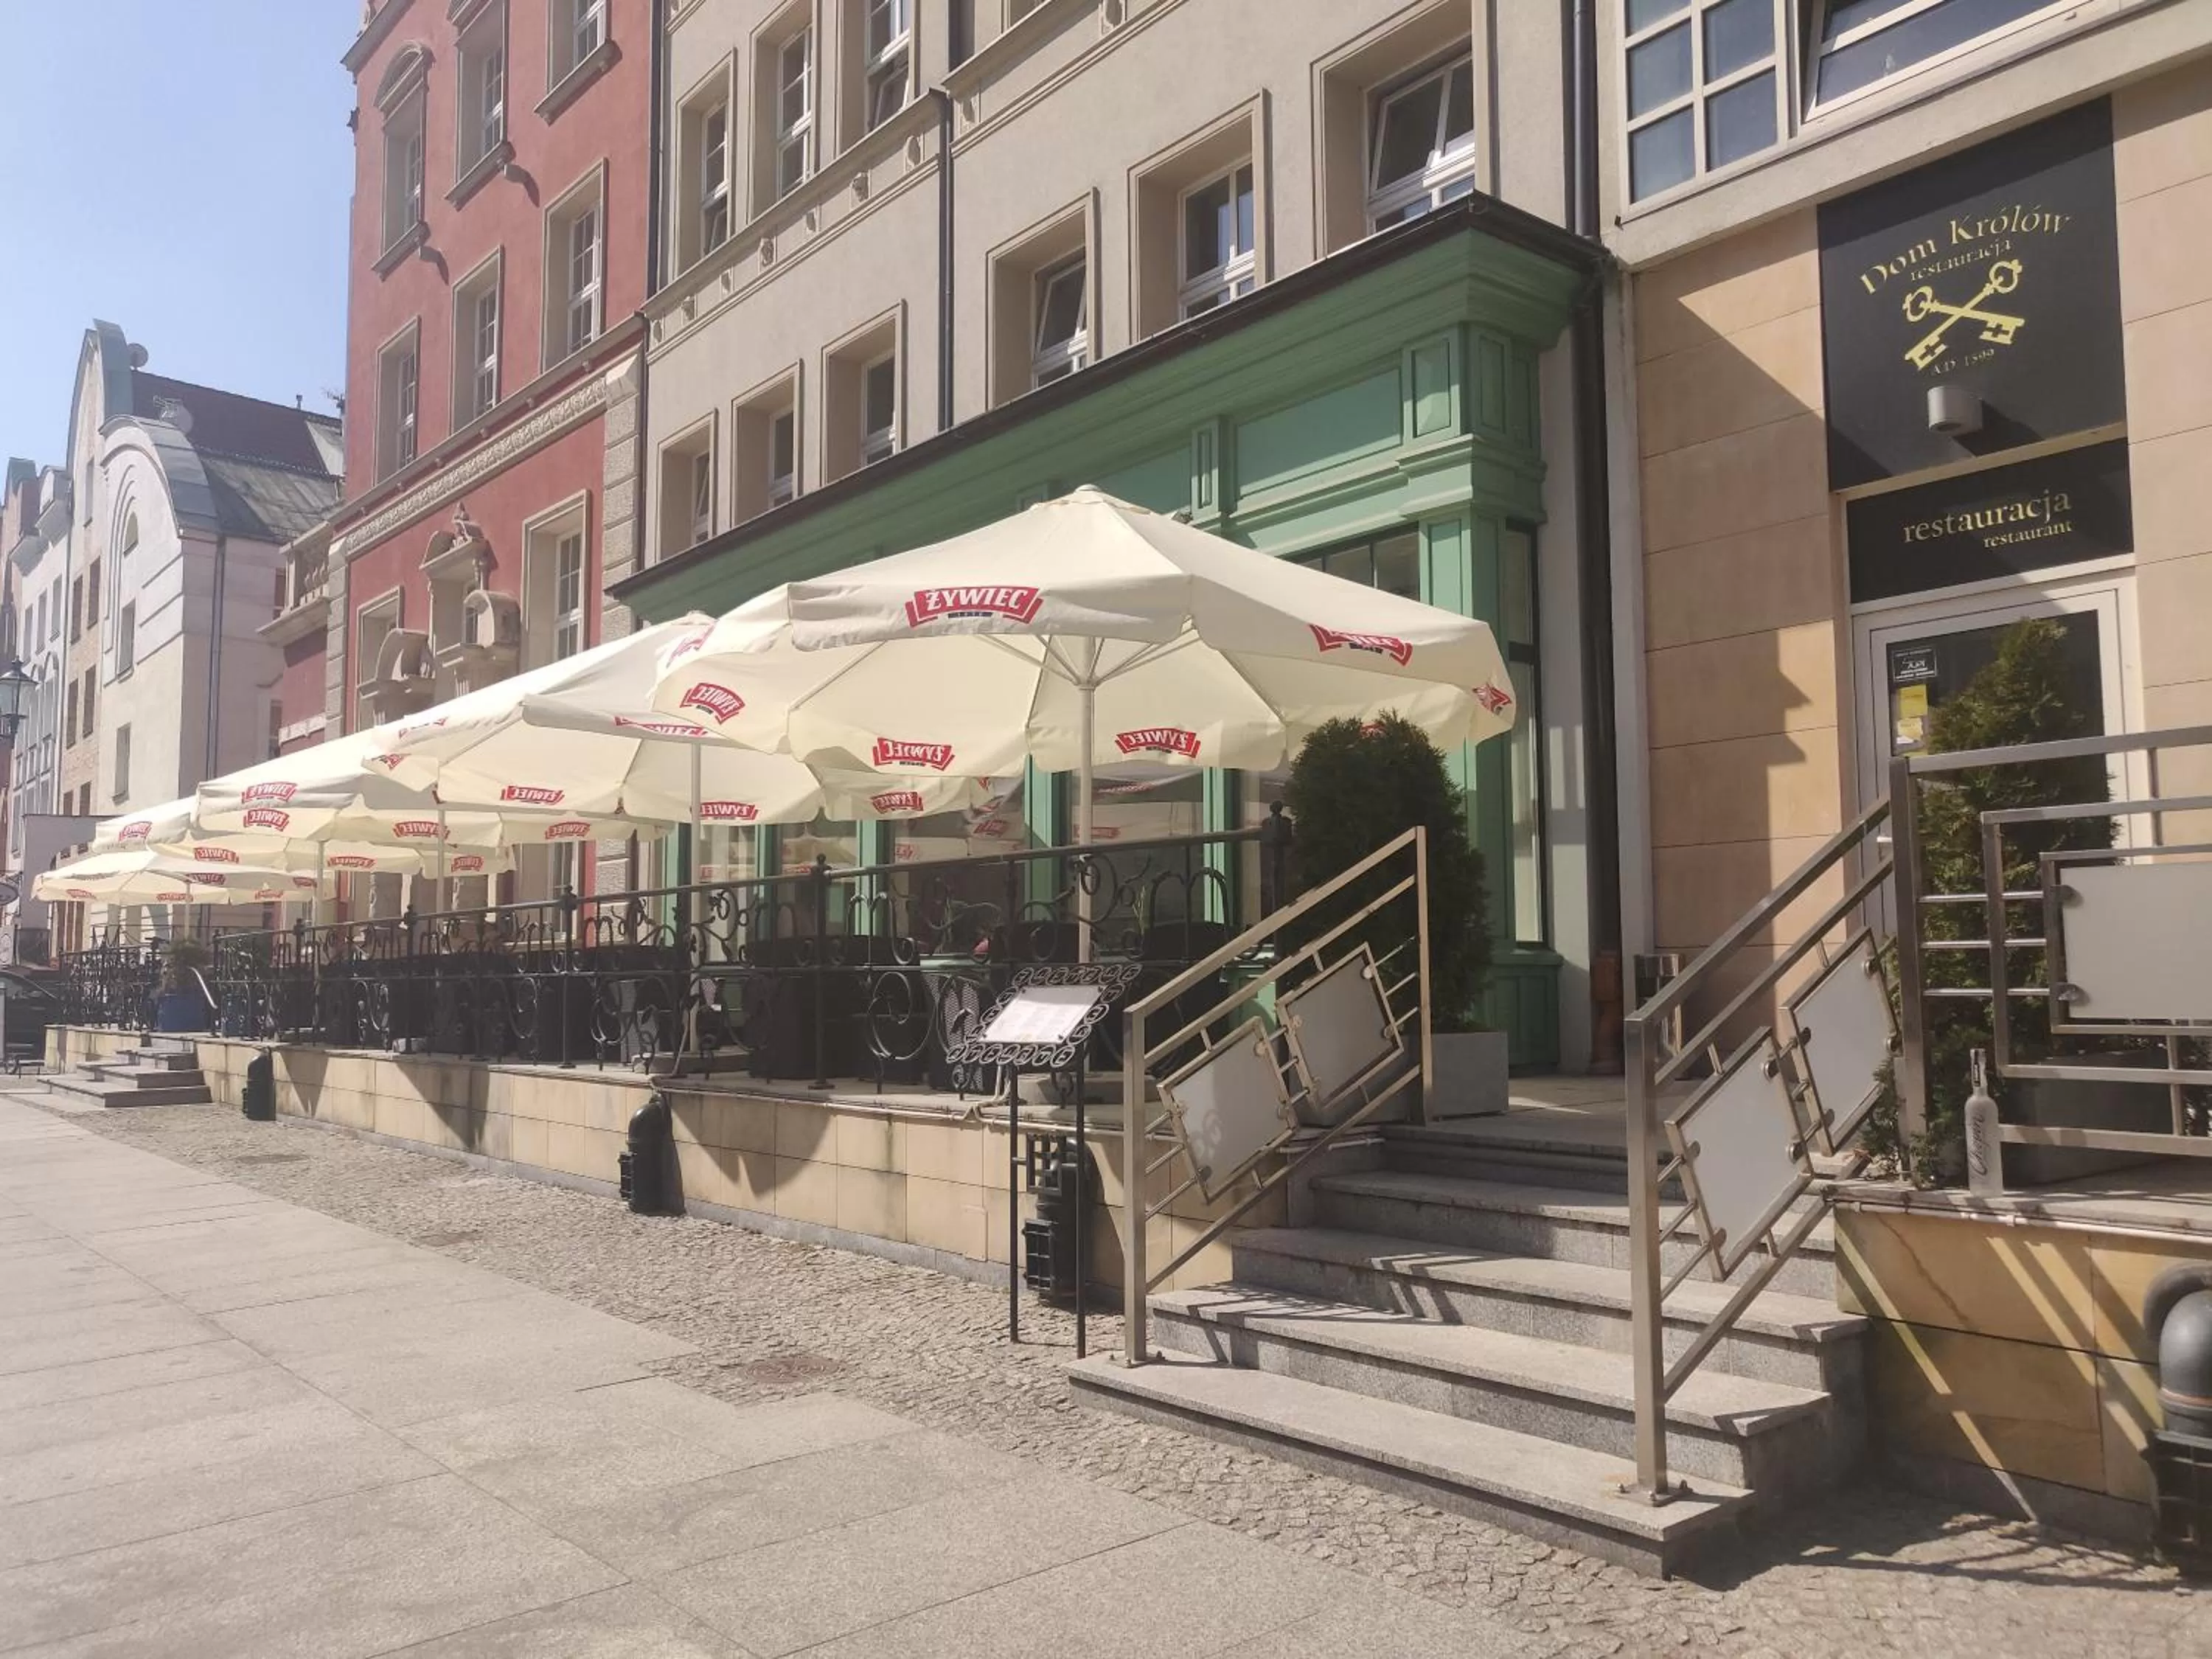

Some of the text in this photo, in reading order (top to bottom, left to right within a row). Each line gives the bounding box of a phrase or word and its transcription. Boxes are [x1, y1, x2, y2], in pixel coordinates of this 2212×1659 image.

[1860, 204, 2070, 295] Dom Królów
[1910, 240, 2014, 282] restauracja
[1903, 489, 2072, 543] restauracja
[1983, 520, 2073, 549] restaurant
[925, 588, 1028, 611] ŻYWIEC
